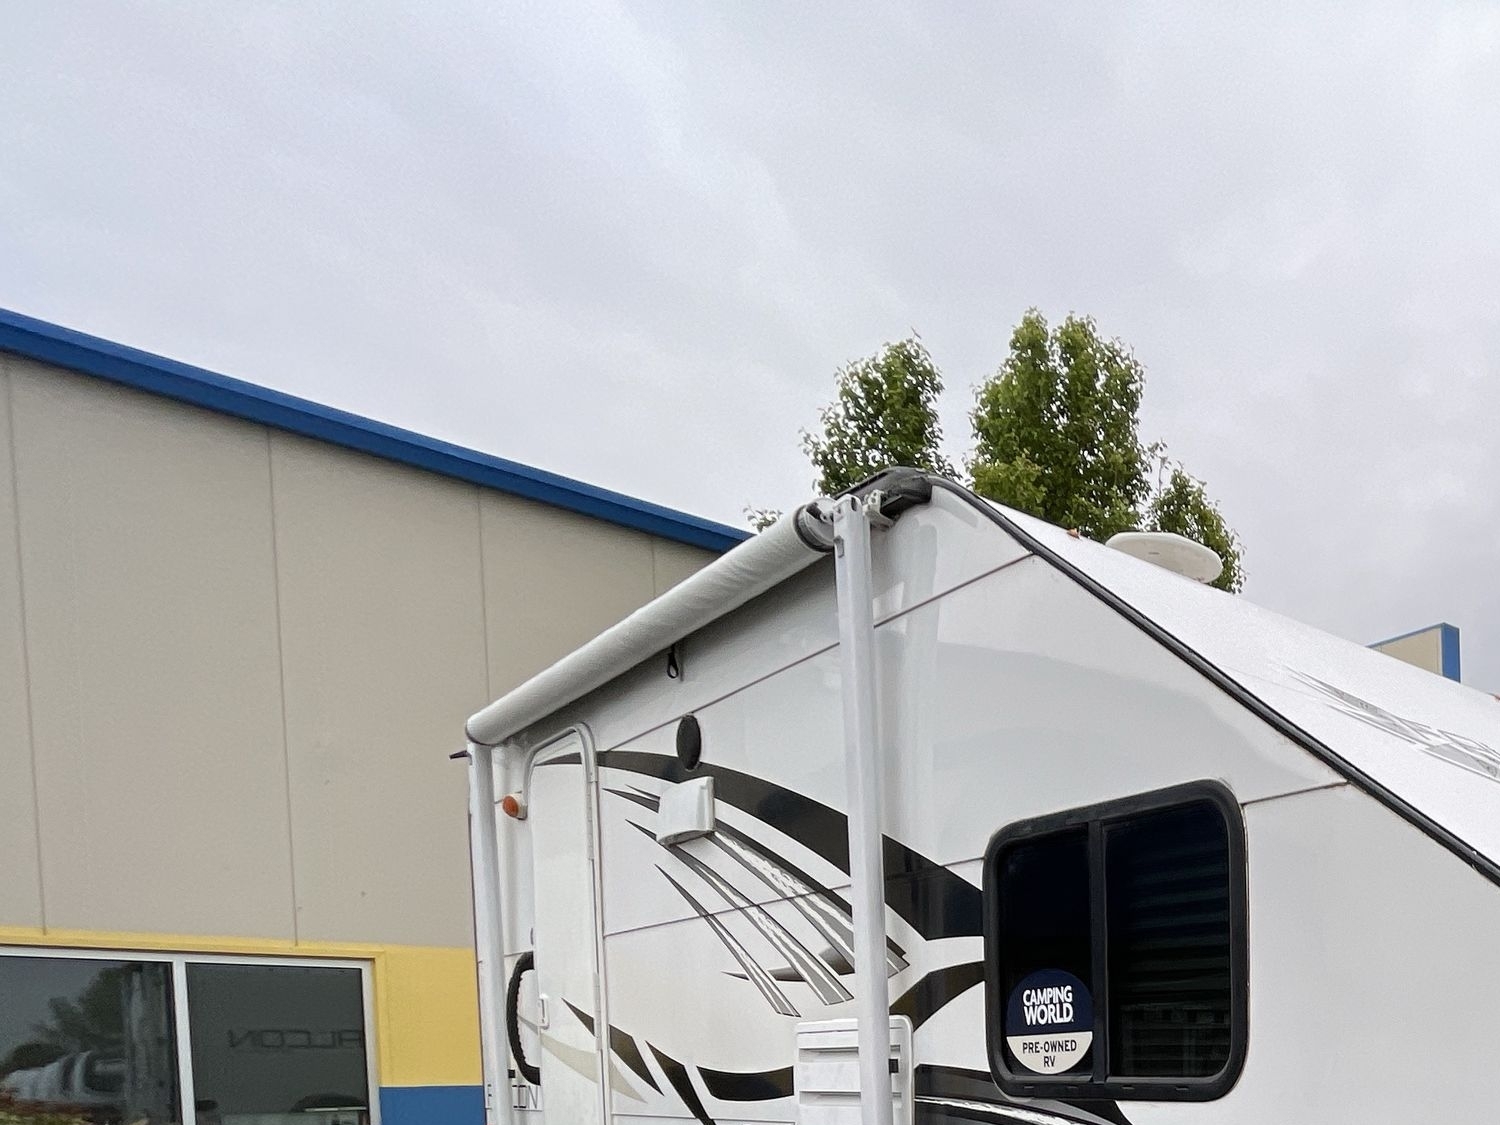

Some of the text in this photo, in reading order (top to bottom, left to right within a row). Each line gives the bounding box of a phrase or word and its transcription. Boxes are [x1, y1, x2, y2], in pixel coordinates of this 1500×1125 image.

[1023, 985, 1073, 1006] CAMPING
[1023, 1002, 1074, 1026] WORLD
[1022, 1040, 1077, 1054] PRE-OWNED
[1043, 1056, 1056, 1067] RV
